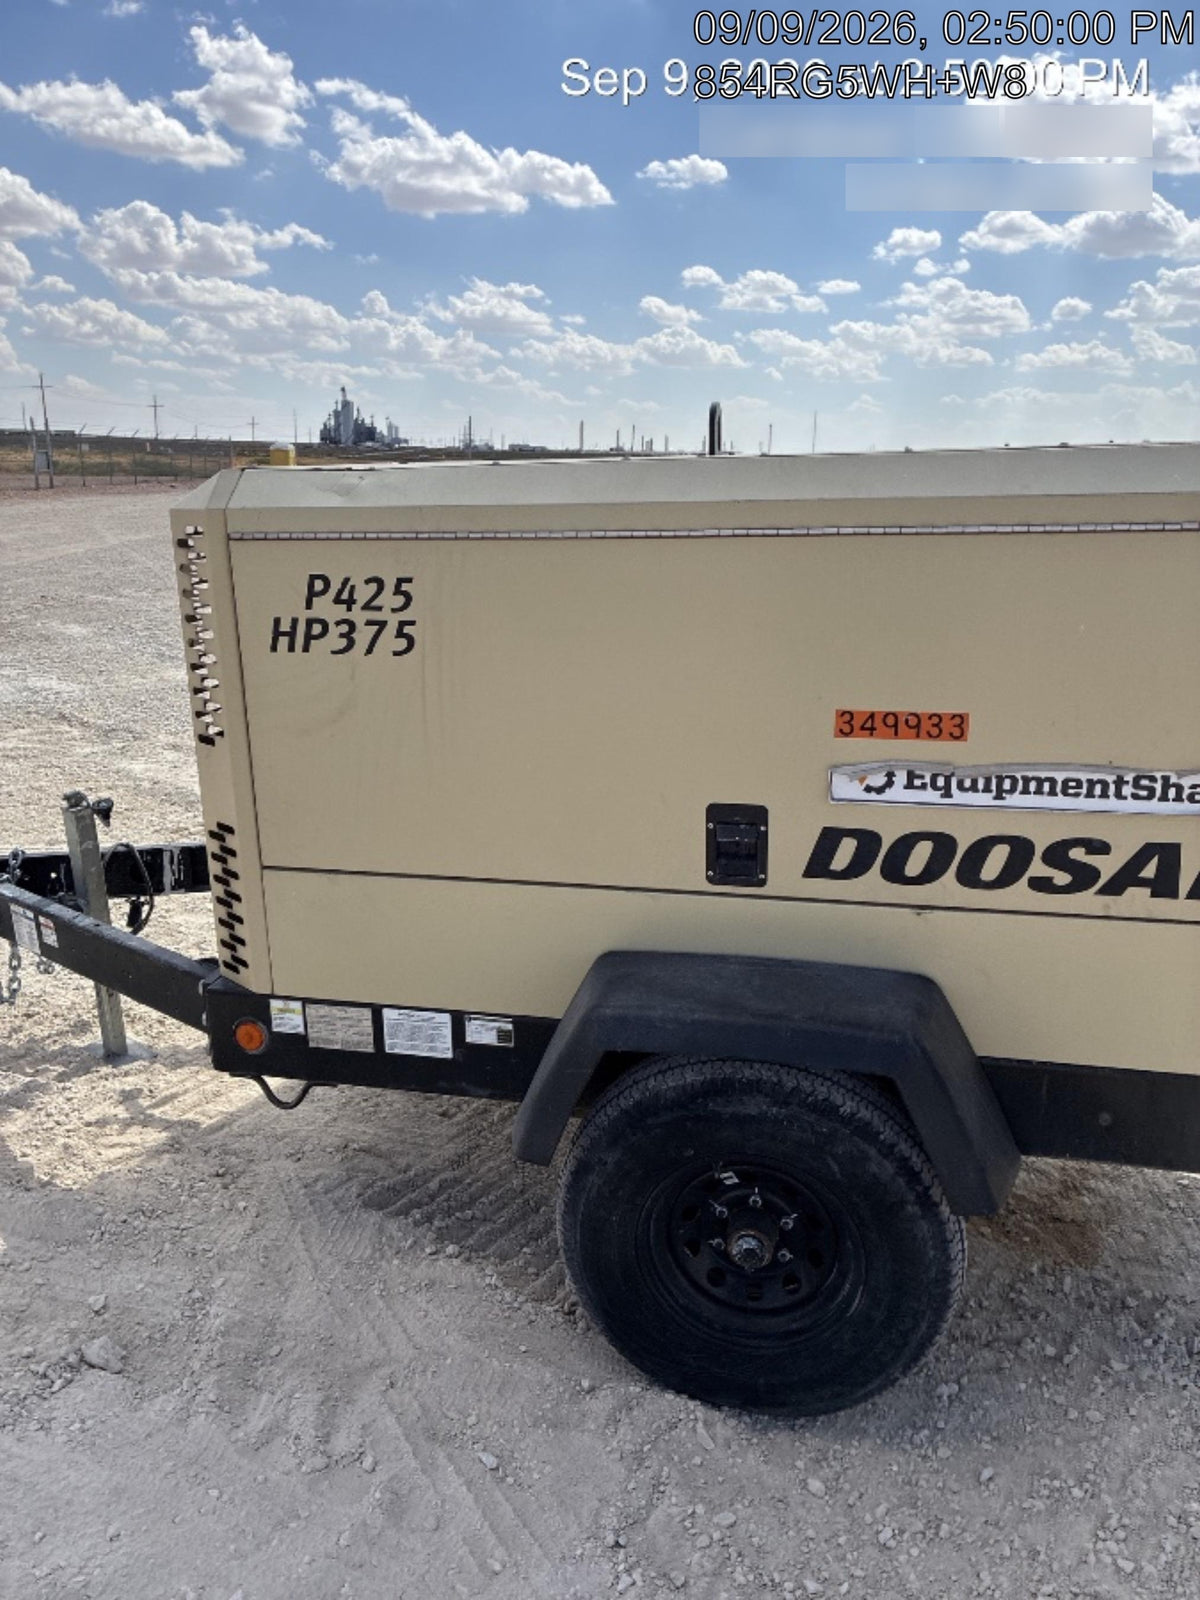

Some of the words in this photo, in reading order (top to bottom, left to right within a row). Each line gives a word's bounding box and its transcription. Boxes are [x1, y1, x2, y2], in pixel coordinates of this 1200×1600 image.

[305, 573, 414, 613] P425
[270, 616, 417, 657] HP375
[838, 710, 965, 740] 349933
[802, 826, 1200, 900] DOOSA
